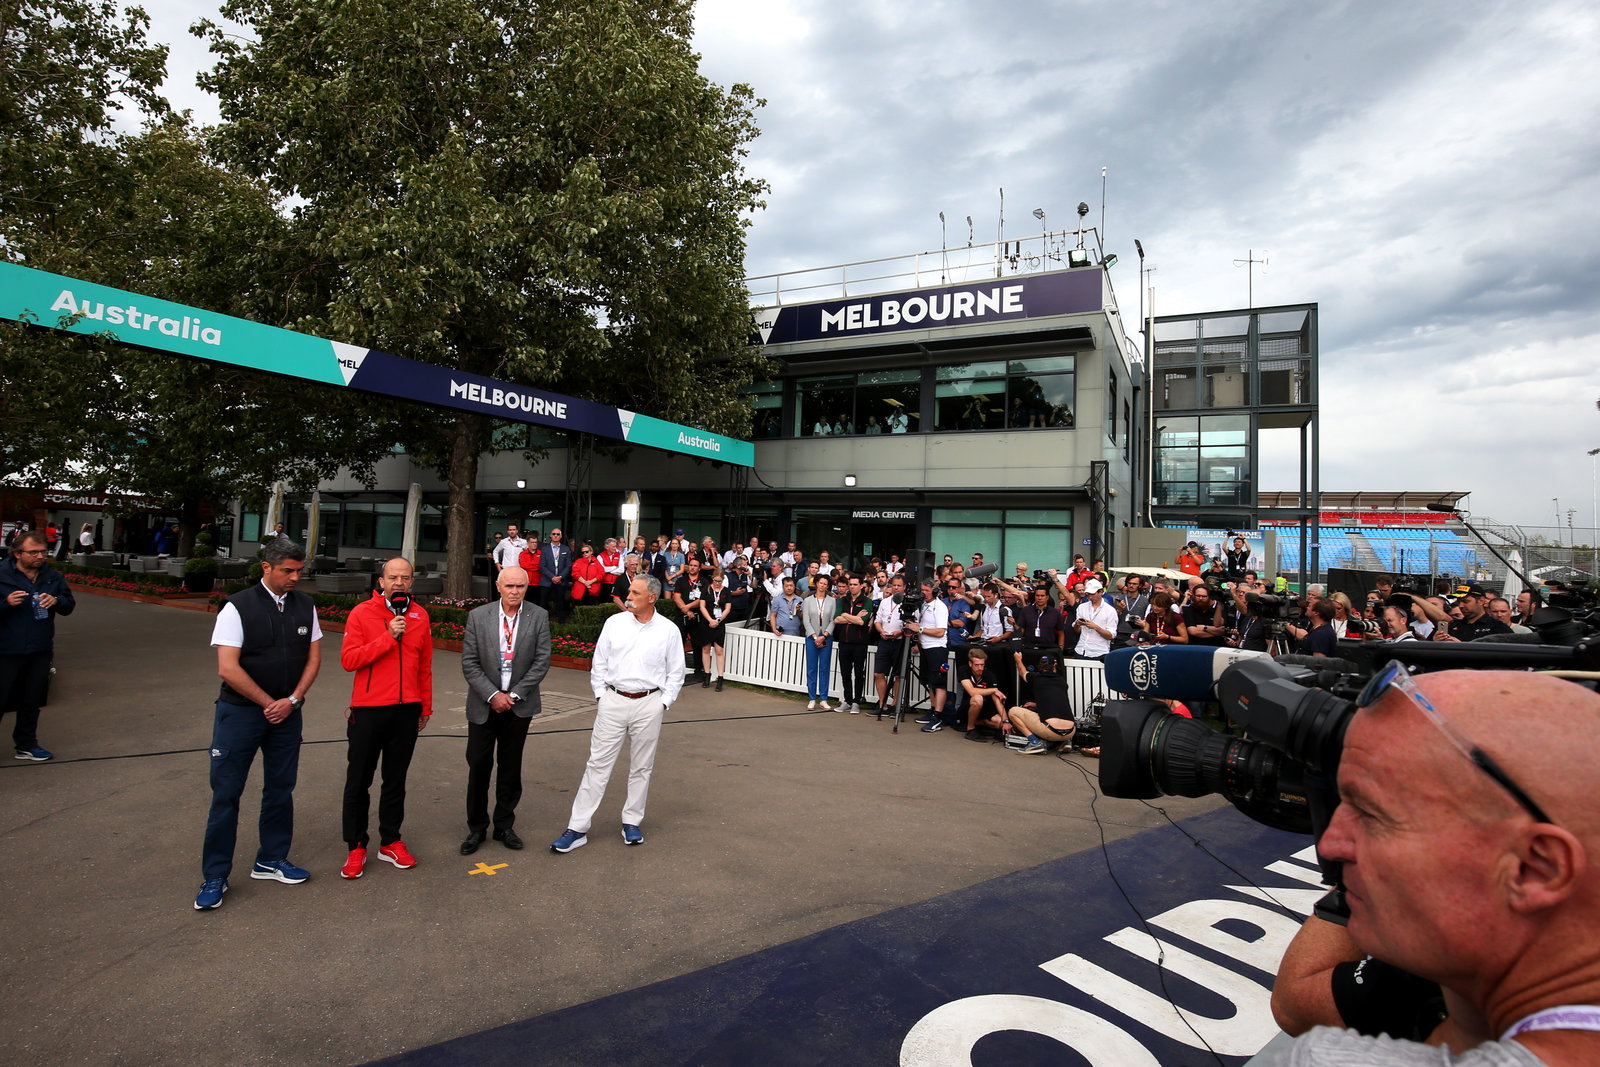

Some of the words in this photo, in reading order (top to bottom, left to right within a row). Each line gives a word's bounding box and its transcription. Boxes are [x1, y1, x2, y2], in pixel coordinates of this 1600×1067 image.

[50, 290, 222, 346] Australia
[821, 285, 1024, 332] MELBOURNE
[757, 320, 775, 329] MEL
[338, 358, 359, 370] MEL
[450, 378, 567, 419] MELBOURNE
[677, 431, 721, 452] Australia
[882, 511, 915, 519] CENTRE
[1133, 659, 1145, 683] FOX
